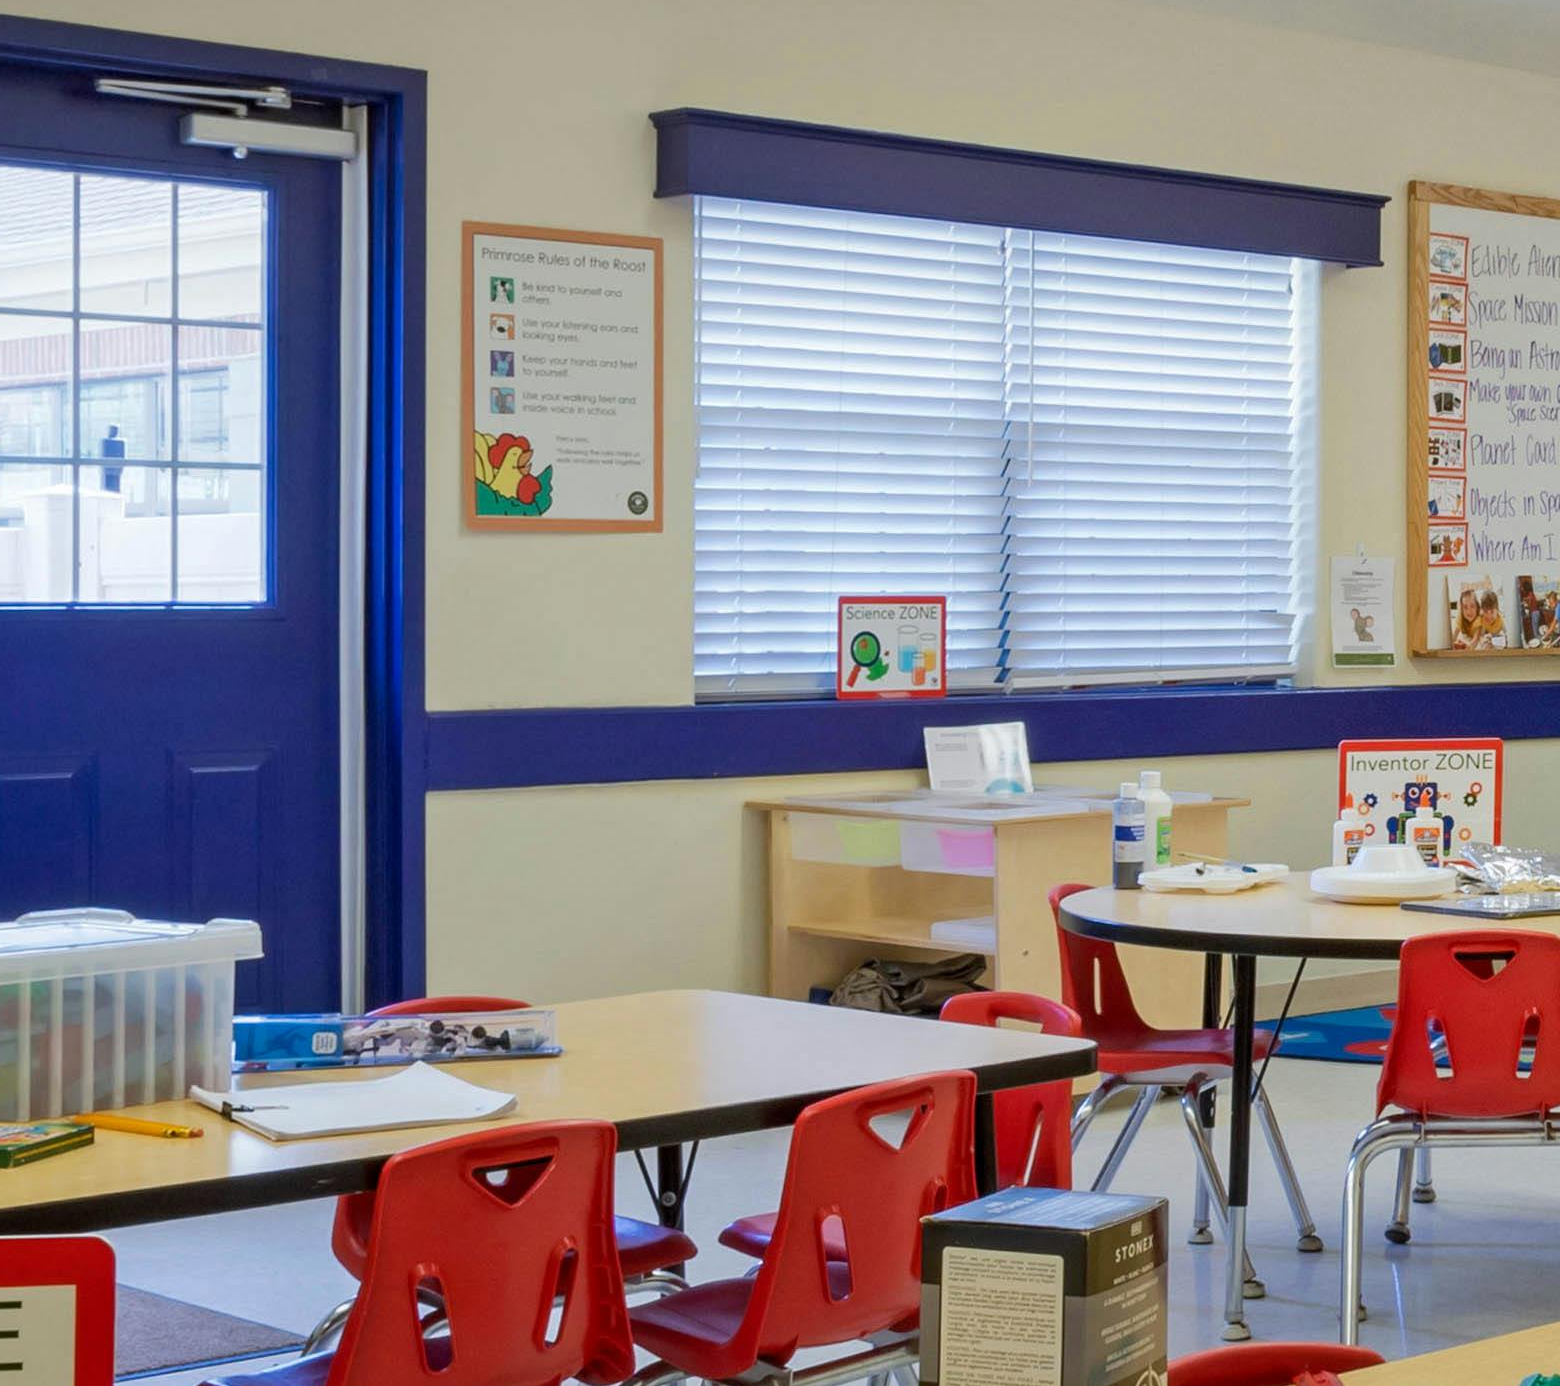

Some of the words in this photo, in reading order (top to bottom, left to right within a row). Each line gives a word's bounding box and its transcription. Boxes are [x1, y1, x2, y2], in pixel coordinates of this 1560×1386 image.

[481, 247, 535, 264] Primrose
[538, 253, 570, 266] Rules
[573, 256, 586, 267] of
[590, 257, 609, 270] the
[613, 258, 646, 273] Roost
[1471, 245, 1520, 278] Edible
[604, 288, 623, 298] and
[1467, 290, 1507, 329] Space
[1514, 293, 1558, 326] Mission
[1469, 378, 1501, 404] Make
[1505, 382, 1526, 407] your
[1529, 384, 1552, 404] own
[1470, 433, 1517, 466] Planet
[1526, 433, 1557, 466] Card
[1470, 488, 1516, 526] Objects
[1523, 492, 1535, 517] in
[1471, 533, 1515, 562] Where
[1521, 535, 1541, 562] Am
[846, 605, 895, 622] Science
[899, 605, 938, 620] ZONE
[1351, 754, 1430, 773] Inventor
[1435, 752, 1493, 770] ZONE
[1114, 1235, 1155, 1263] STONEX
